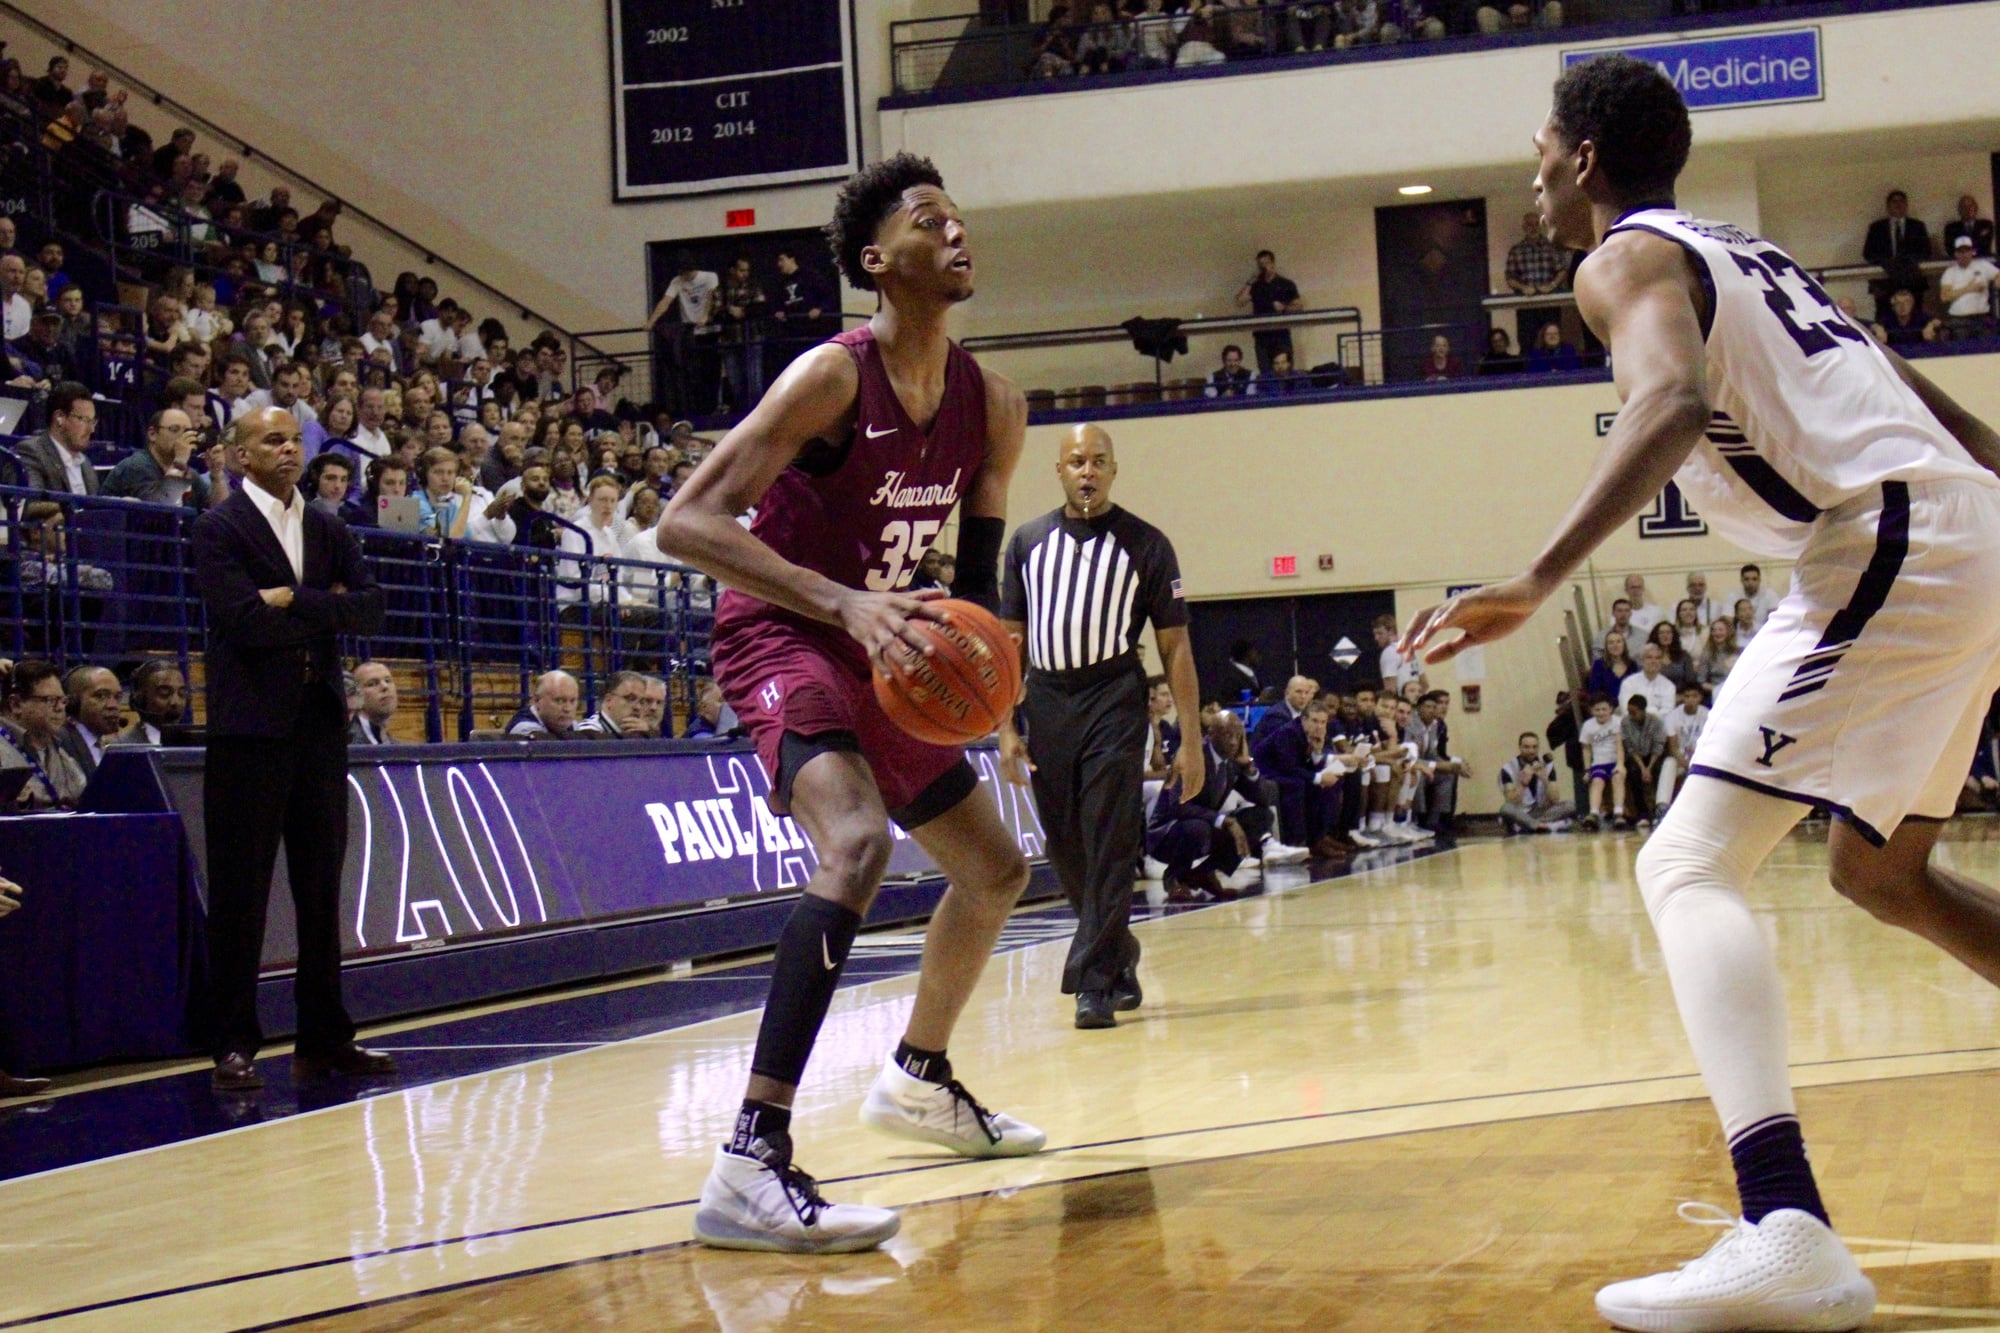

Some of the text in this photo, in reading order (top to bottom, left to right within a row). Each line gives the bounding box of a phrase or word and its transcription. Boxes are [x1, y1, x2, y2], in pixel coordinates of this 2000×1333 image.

[647, 27, 689, 44] 2002
[1657, 55, 1812, 91] Medicine
[715, 91, 750, 109] CIT
[651, 120, 757, 144] 2012 2014
[130, 236, 160, 249] 205
[864, 520, 941, 592] 35
[761, 681, 780, 710] H
[893, 642, 970, 720] SPALDIN
[1755, 725, 1798, 768] Y
[644, 797, 759, 865] PAUL
